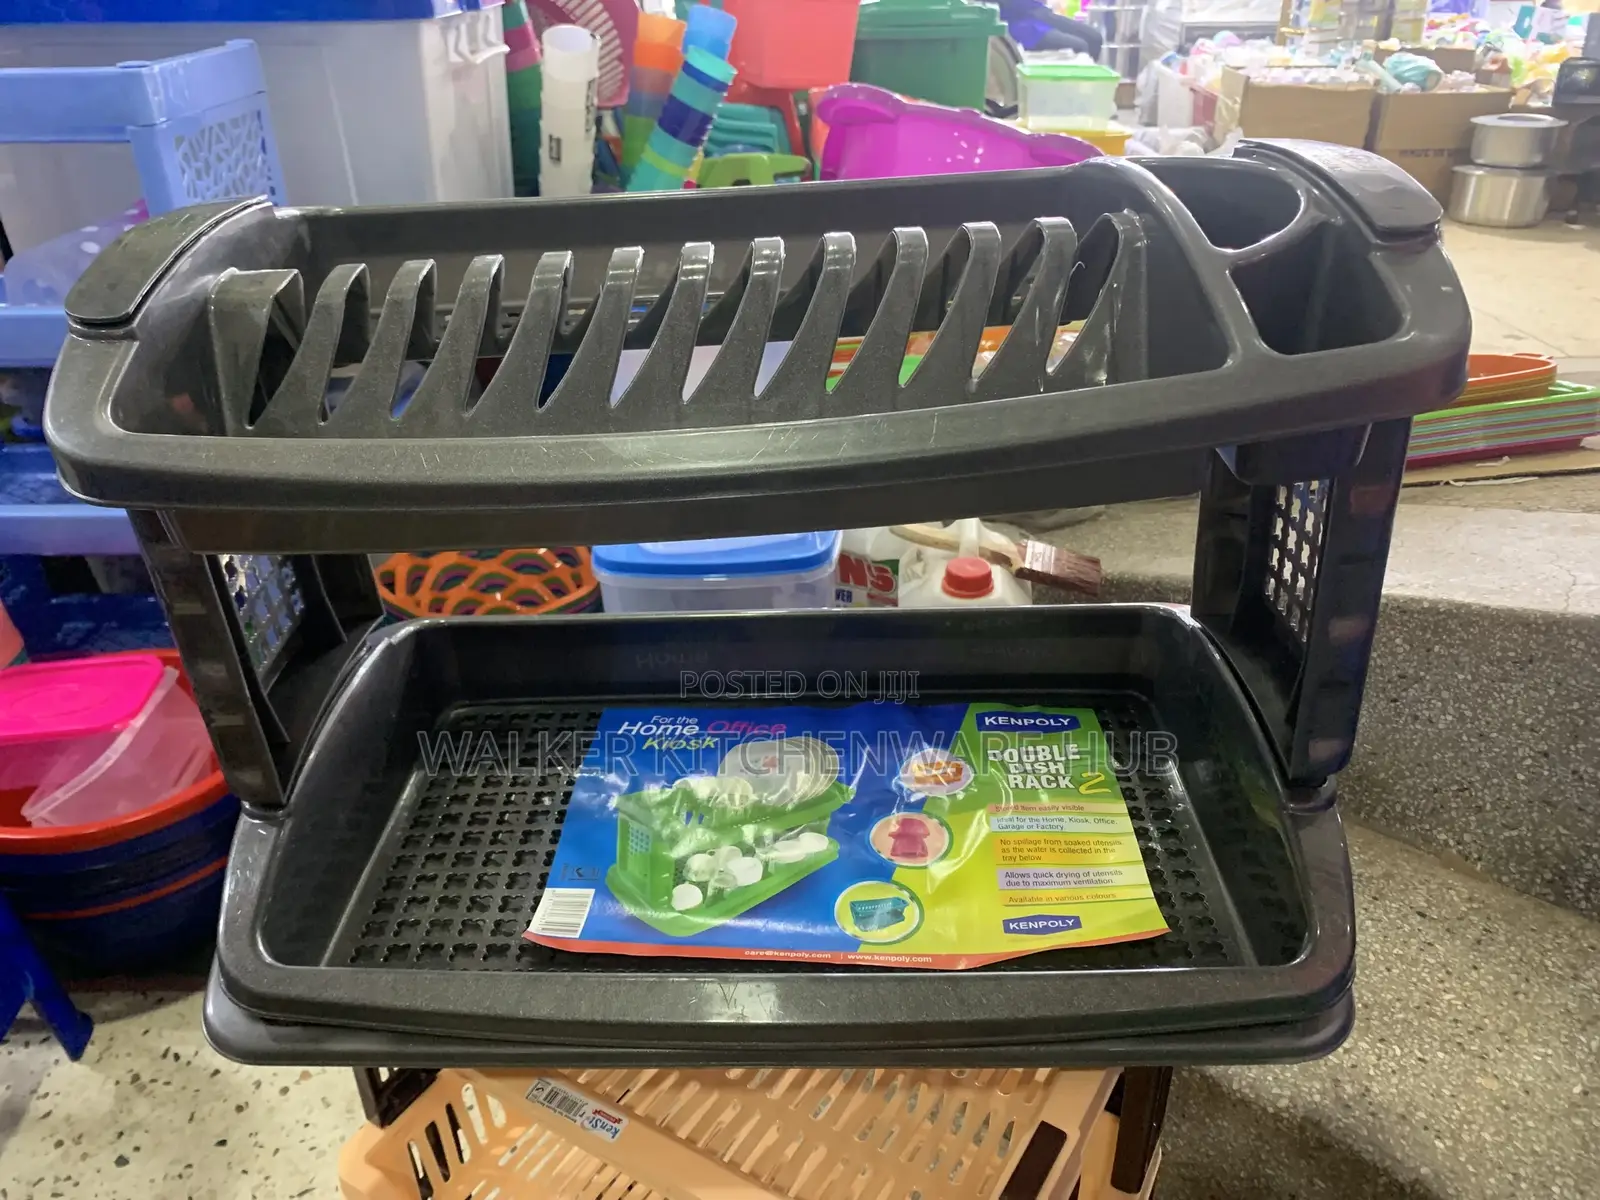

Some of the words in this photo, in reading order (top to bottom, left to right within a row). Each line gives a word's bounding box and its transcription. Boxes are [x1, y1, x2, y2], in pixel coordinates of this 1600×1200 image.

[650, 715, 674, 725] For
[677, 715, 698, 725] the
[984, 715, 1071, 726] KENPOLY
[617, 720, 700, 736] Home
[707, 720, 788, 735] Office
[642, 736, 720, 750] Kiosk
[987, 744, 1080, 763] DOUBLE
[1008, 761, 1066, 775] DISH
[1007, 774, 1076, 789] RACK
[1078, 772, 1112, 795] 2
[1038, 805, 1060, 814] easily
[1061, 804, 1085, 812] visible
[998, 824, 1025, 832] Garage
[1000, 838, 1012, 846] No
[1012, 839, 1042, 848] spillage
[1043, 838, 1062, 846] from
[1058, 847, 1093, 855] collected
[1002, 854, 1017, 862] tray
[1004, 871, 1031, 879] Allows
[1032, 870, 1054, 879] quick
[1055, 870, 1081, 879] drying
[1082, 870, 1091, 878] of
[1092, 868, 1123, 877] utensils
[1005, 879, 1021, 887] due
[1022, 879, 1031, 887] to
[1008, 896, 1043, 904] Available
[1009, 919, 1075, 930] KENPOLY
[744, 949, 832, 960] care@kenpoly.com
[847, 954, 933, 964] www.kenpoly.com
